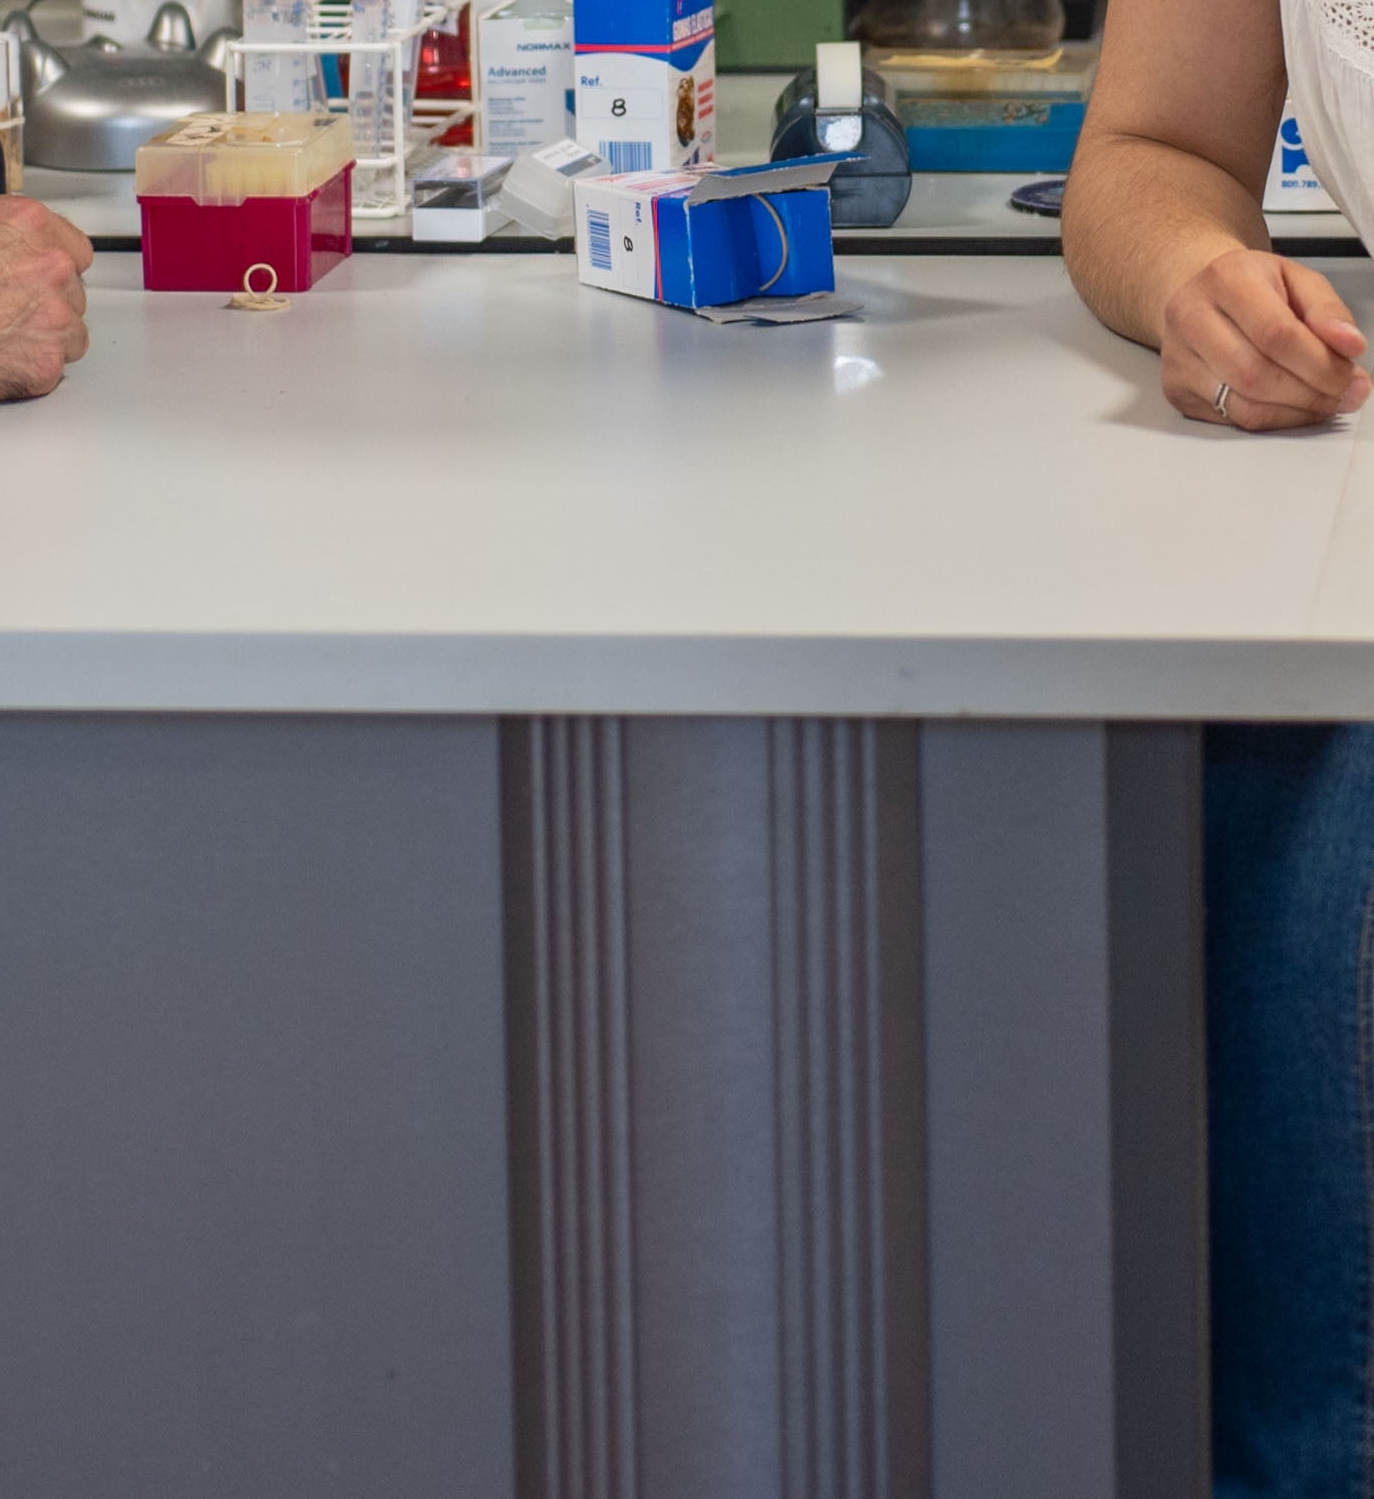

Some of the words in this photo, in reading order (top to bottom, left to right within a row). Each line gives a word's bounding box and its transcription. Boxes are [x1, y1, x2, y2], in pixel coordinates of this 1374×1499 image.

[517, 42, 571, 52] NORMAX
[488, 65, 547, 78] Advanced
[580, 75, 602, 87] Ref.
[611, 97, 627, 117] 8
[634, 201, 642, 228] Ref.
